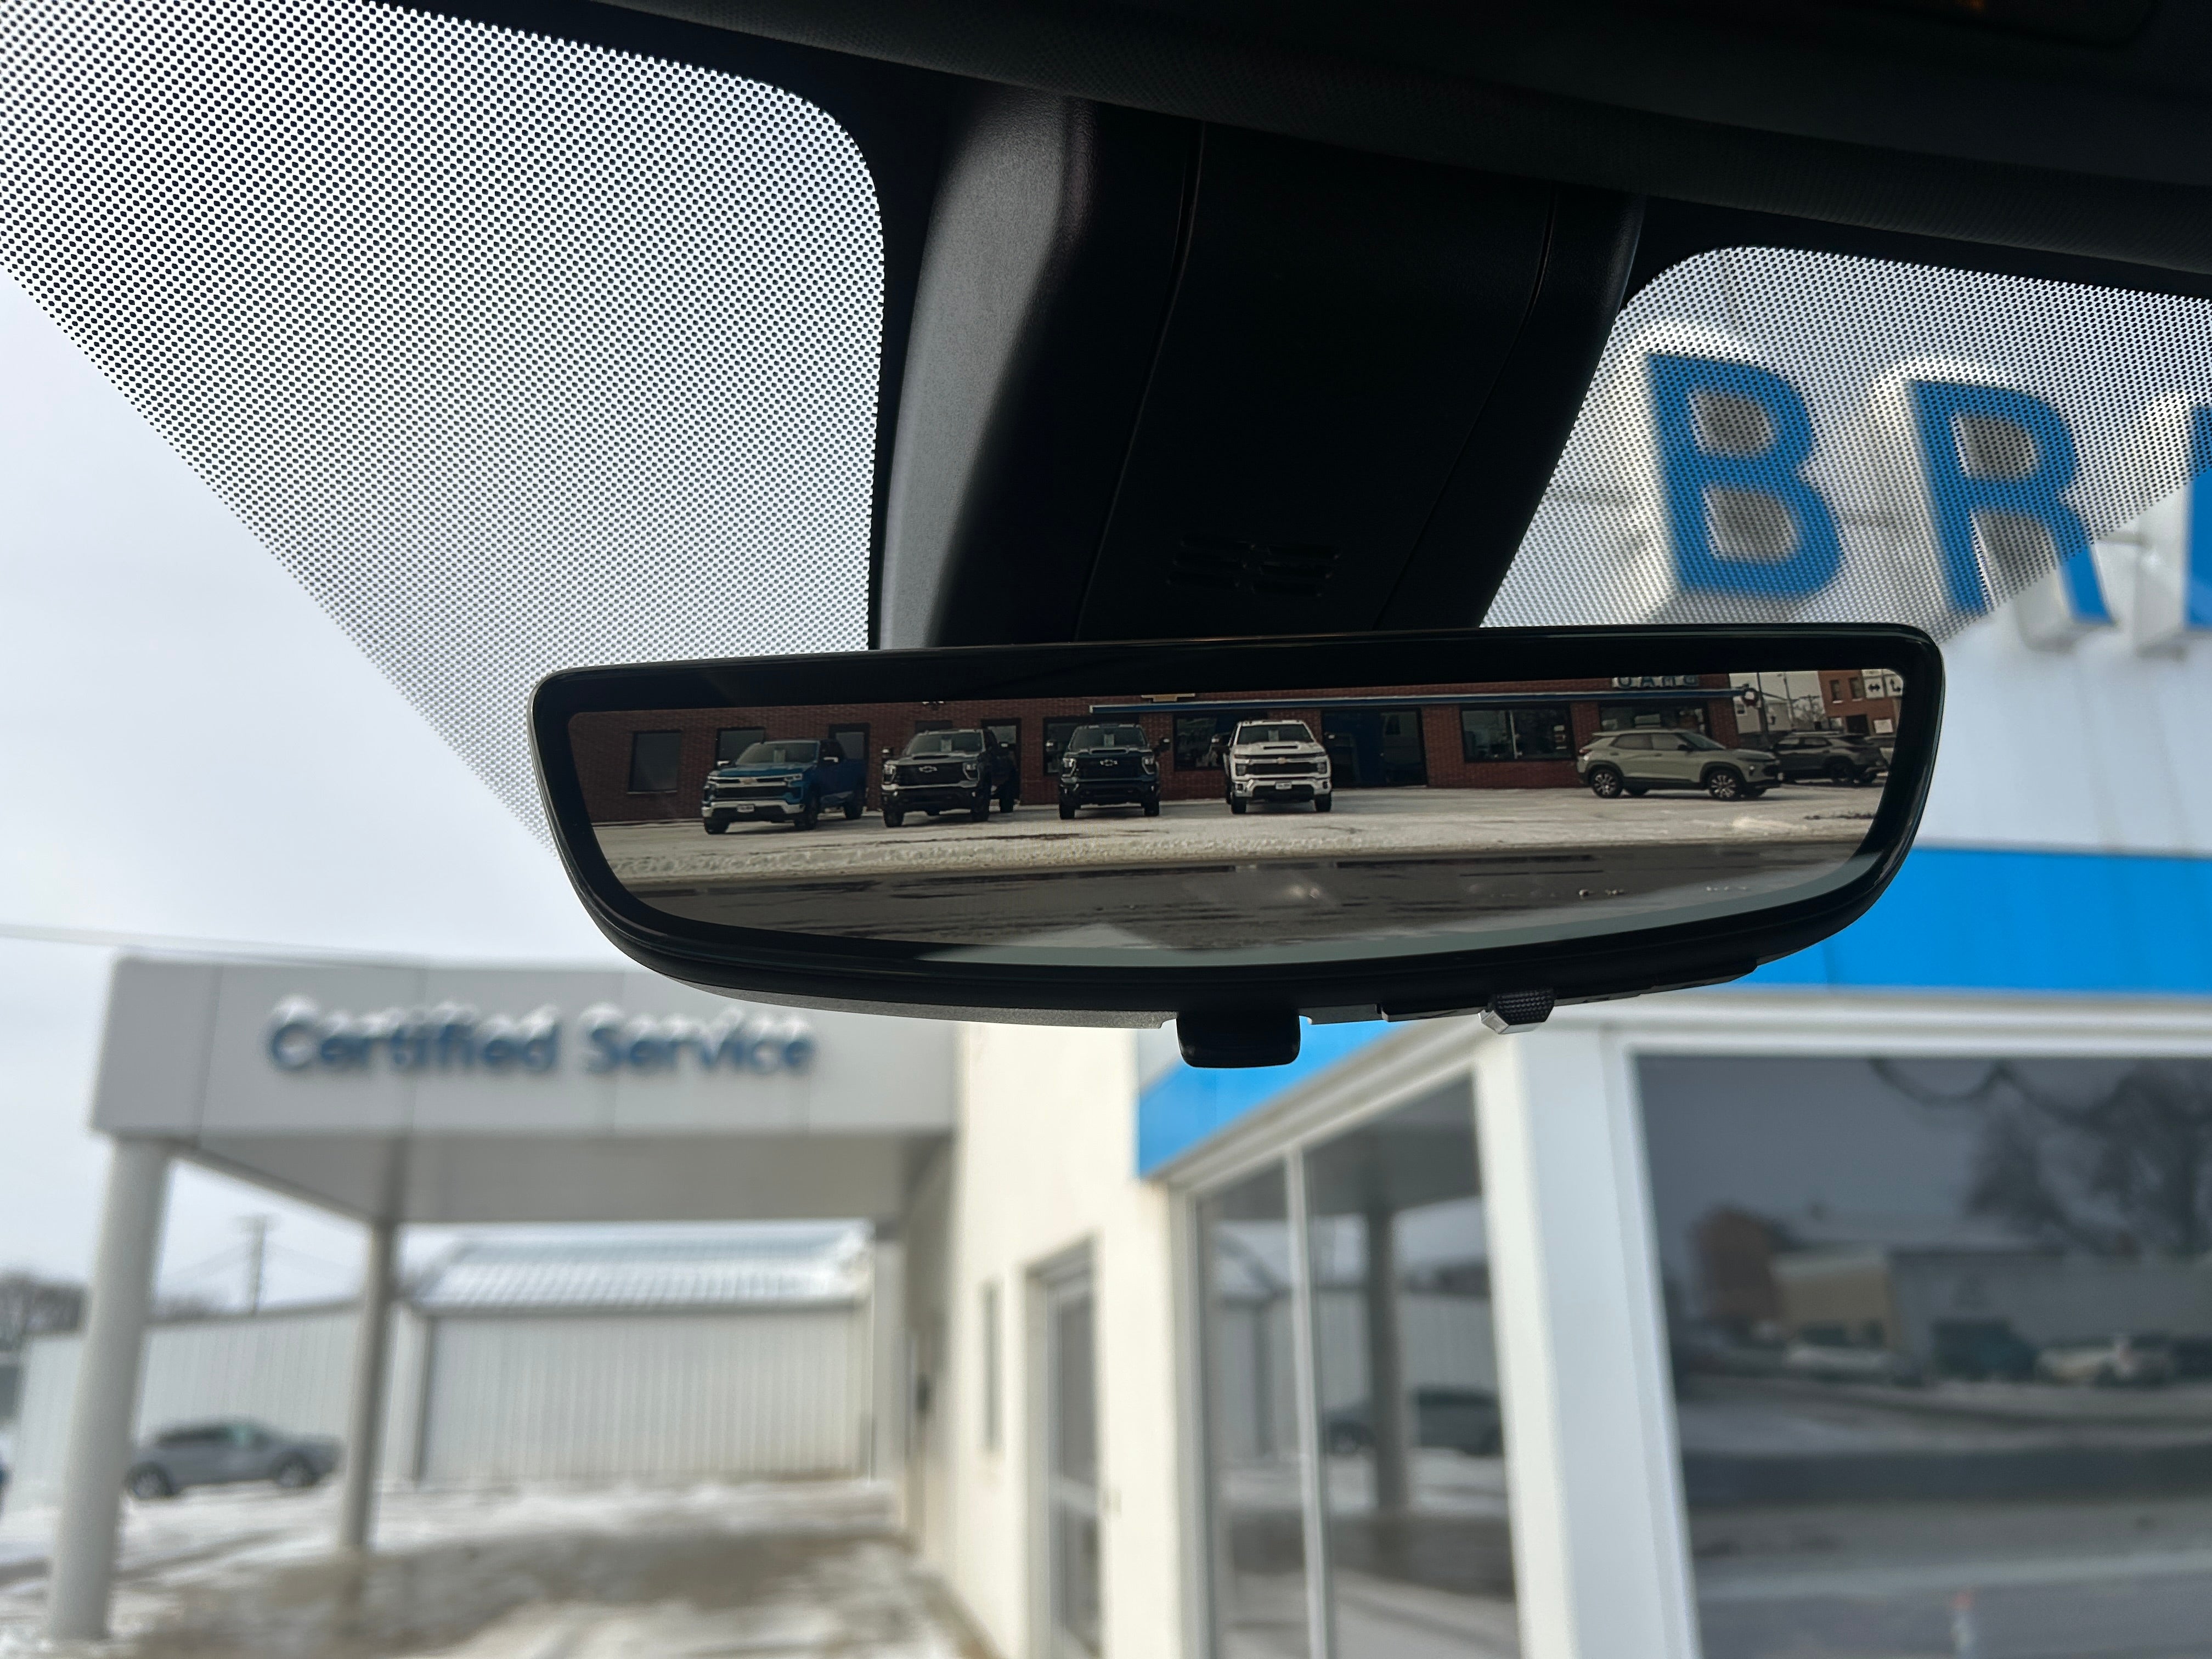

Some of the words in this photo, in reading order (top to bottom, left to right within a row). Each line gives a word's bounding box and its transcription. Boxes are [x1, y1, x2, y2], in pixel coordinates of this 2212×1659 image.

[1646, 351, 2212, 628] BR
[271, 1015, 564, 1073] Certified
[583, 1019, 814, 1073] Service
